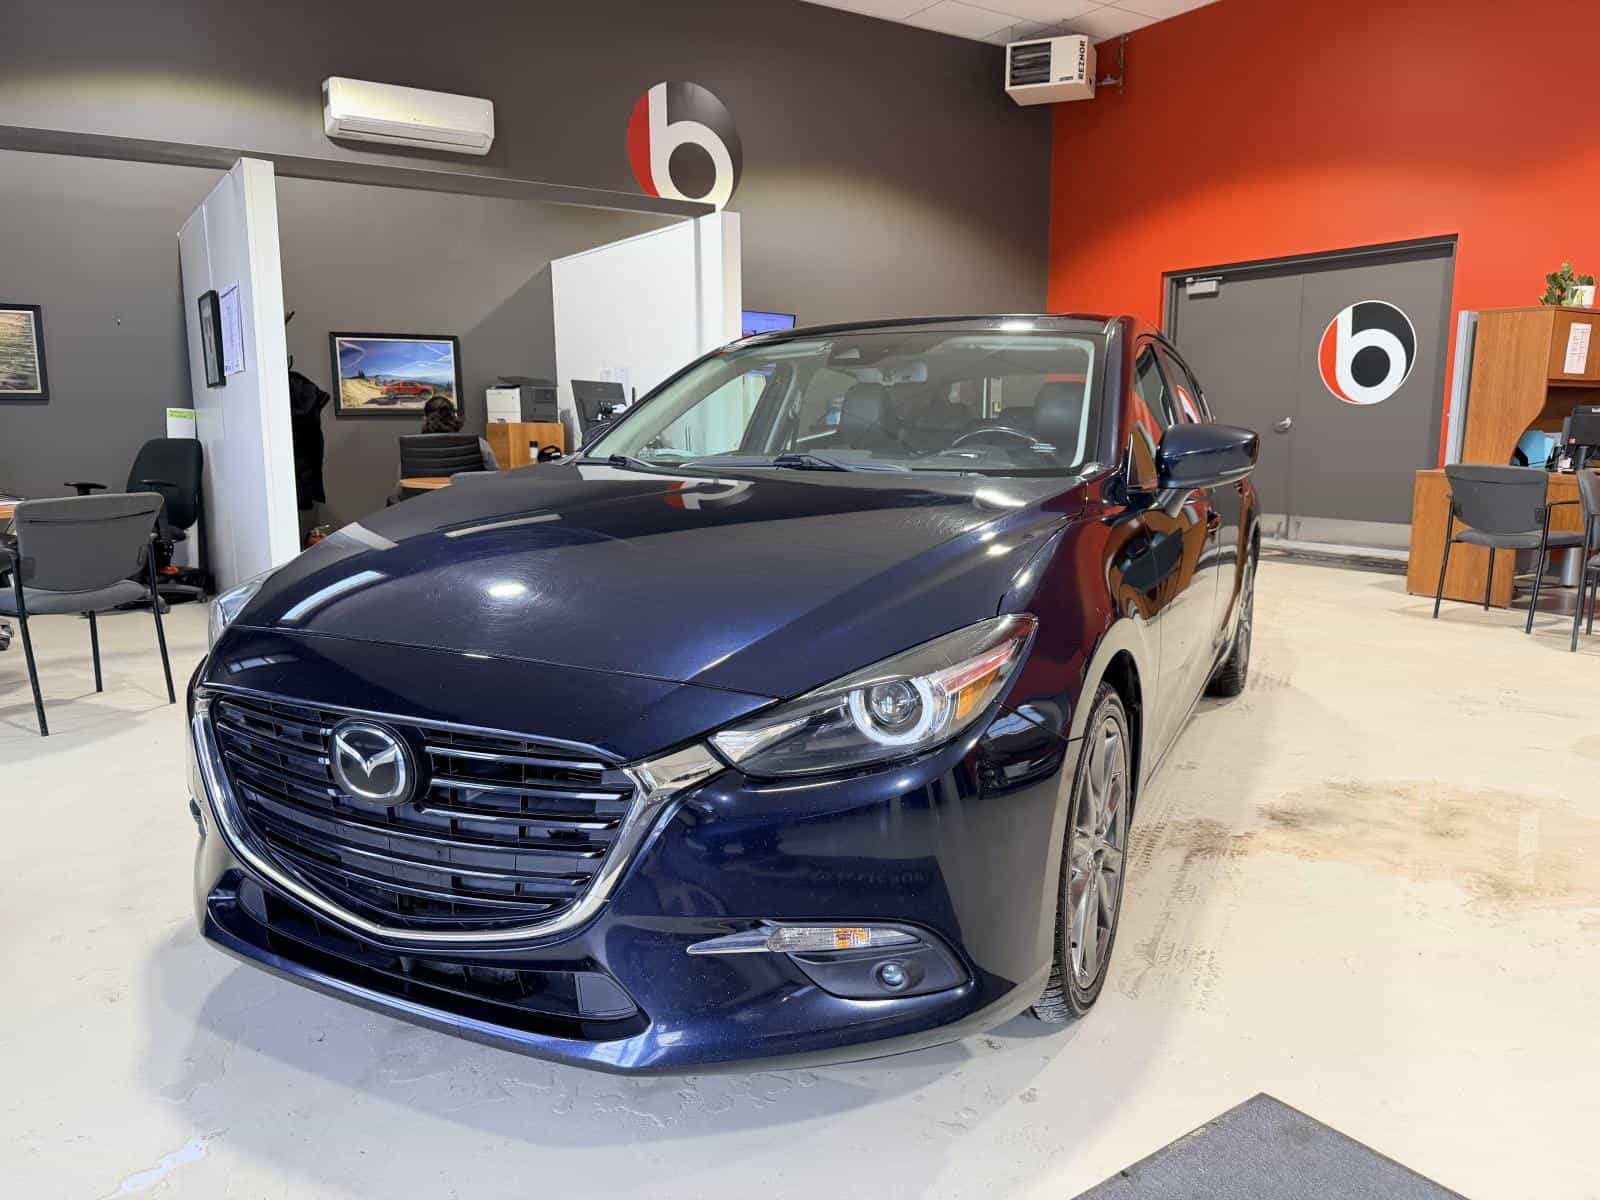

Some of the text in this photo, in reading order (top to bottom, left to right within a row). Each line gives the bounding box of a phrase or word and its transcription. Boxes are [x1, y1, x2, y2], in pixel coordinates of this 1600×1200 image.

[1078, 40, 1086, 80] REZNOR
[648, 81, 734, 212] b
[1335, 304, 1407, 404] b
